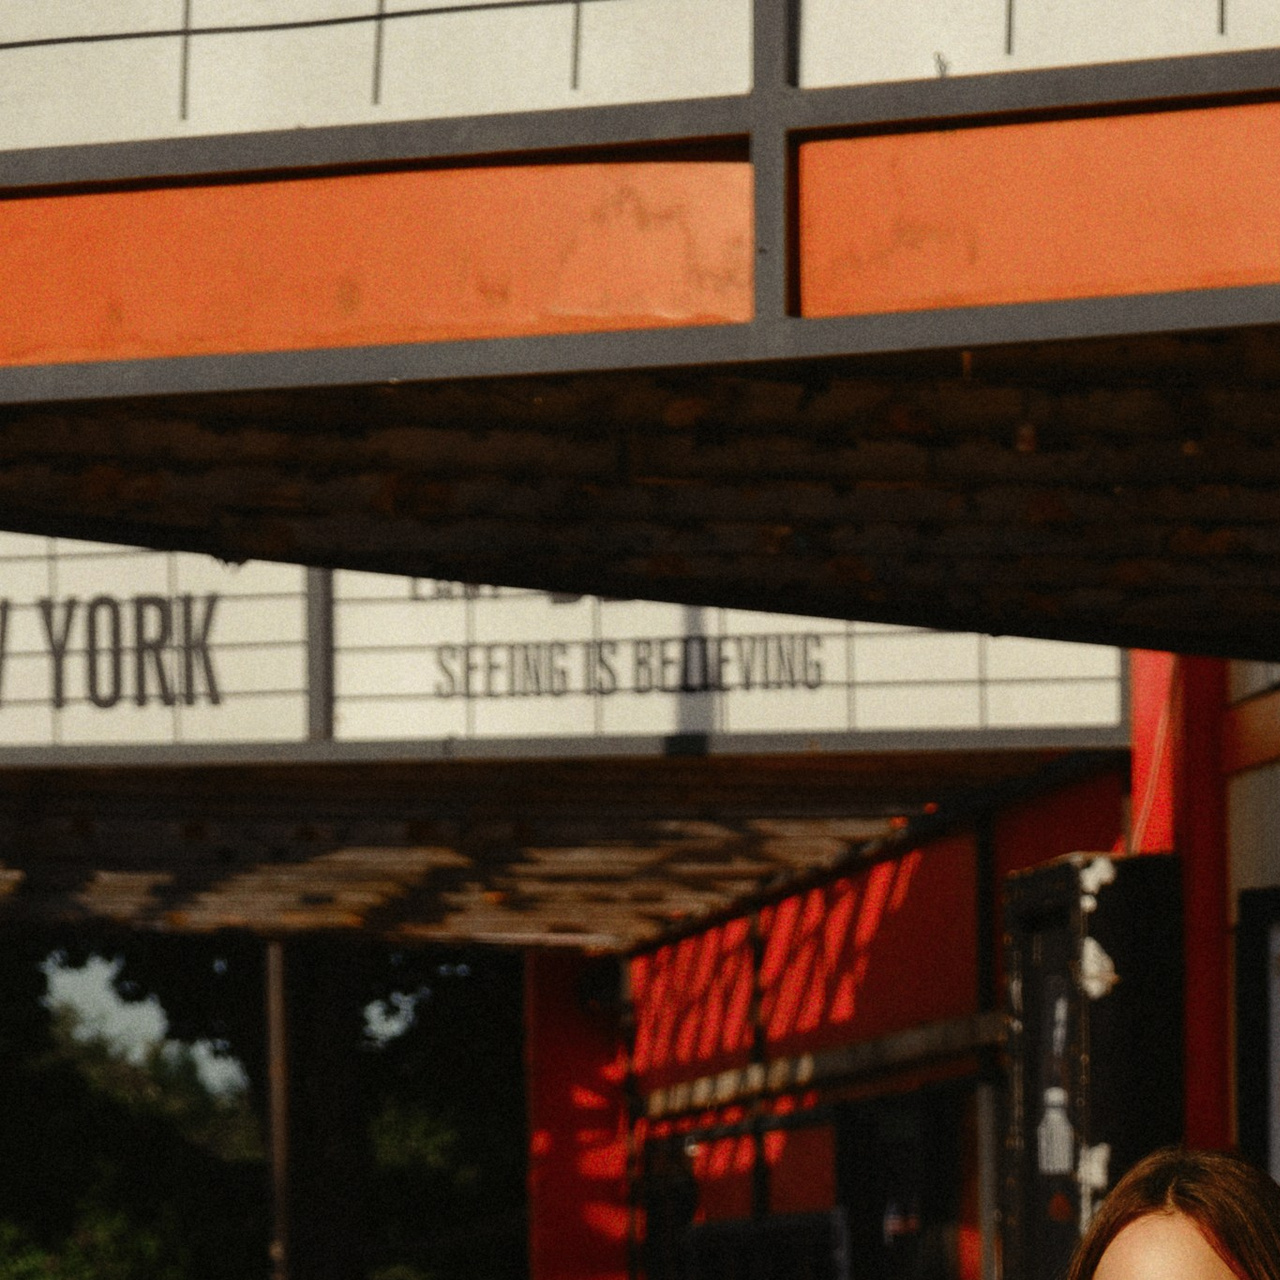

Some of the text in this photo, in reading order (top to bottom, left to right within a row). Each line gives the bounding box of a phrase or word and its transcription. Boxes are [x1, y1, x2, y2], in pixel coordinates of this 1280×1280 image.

[40, 594, 220, 707] YORK
[434, 634, 822, 697] SEEING IS BELIEVING
